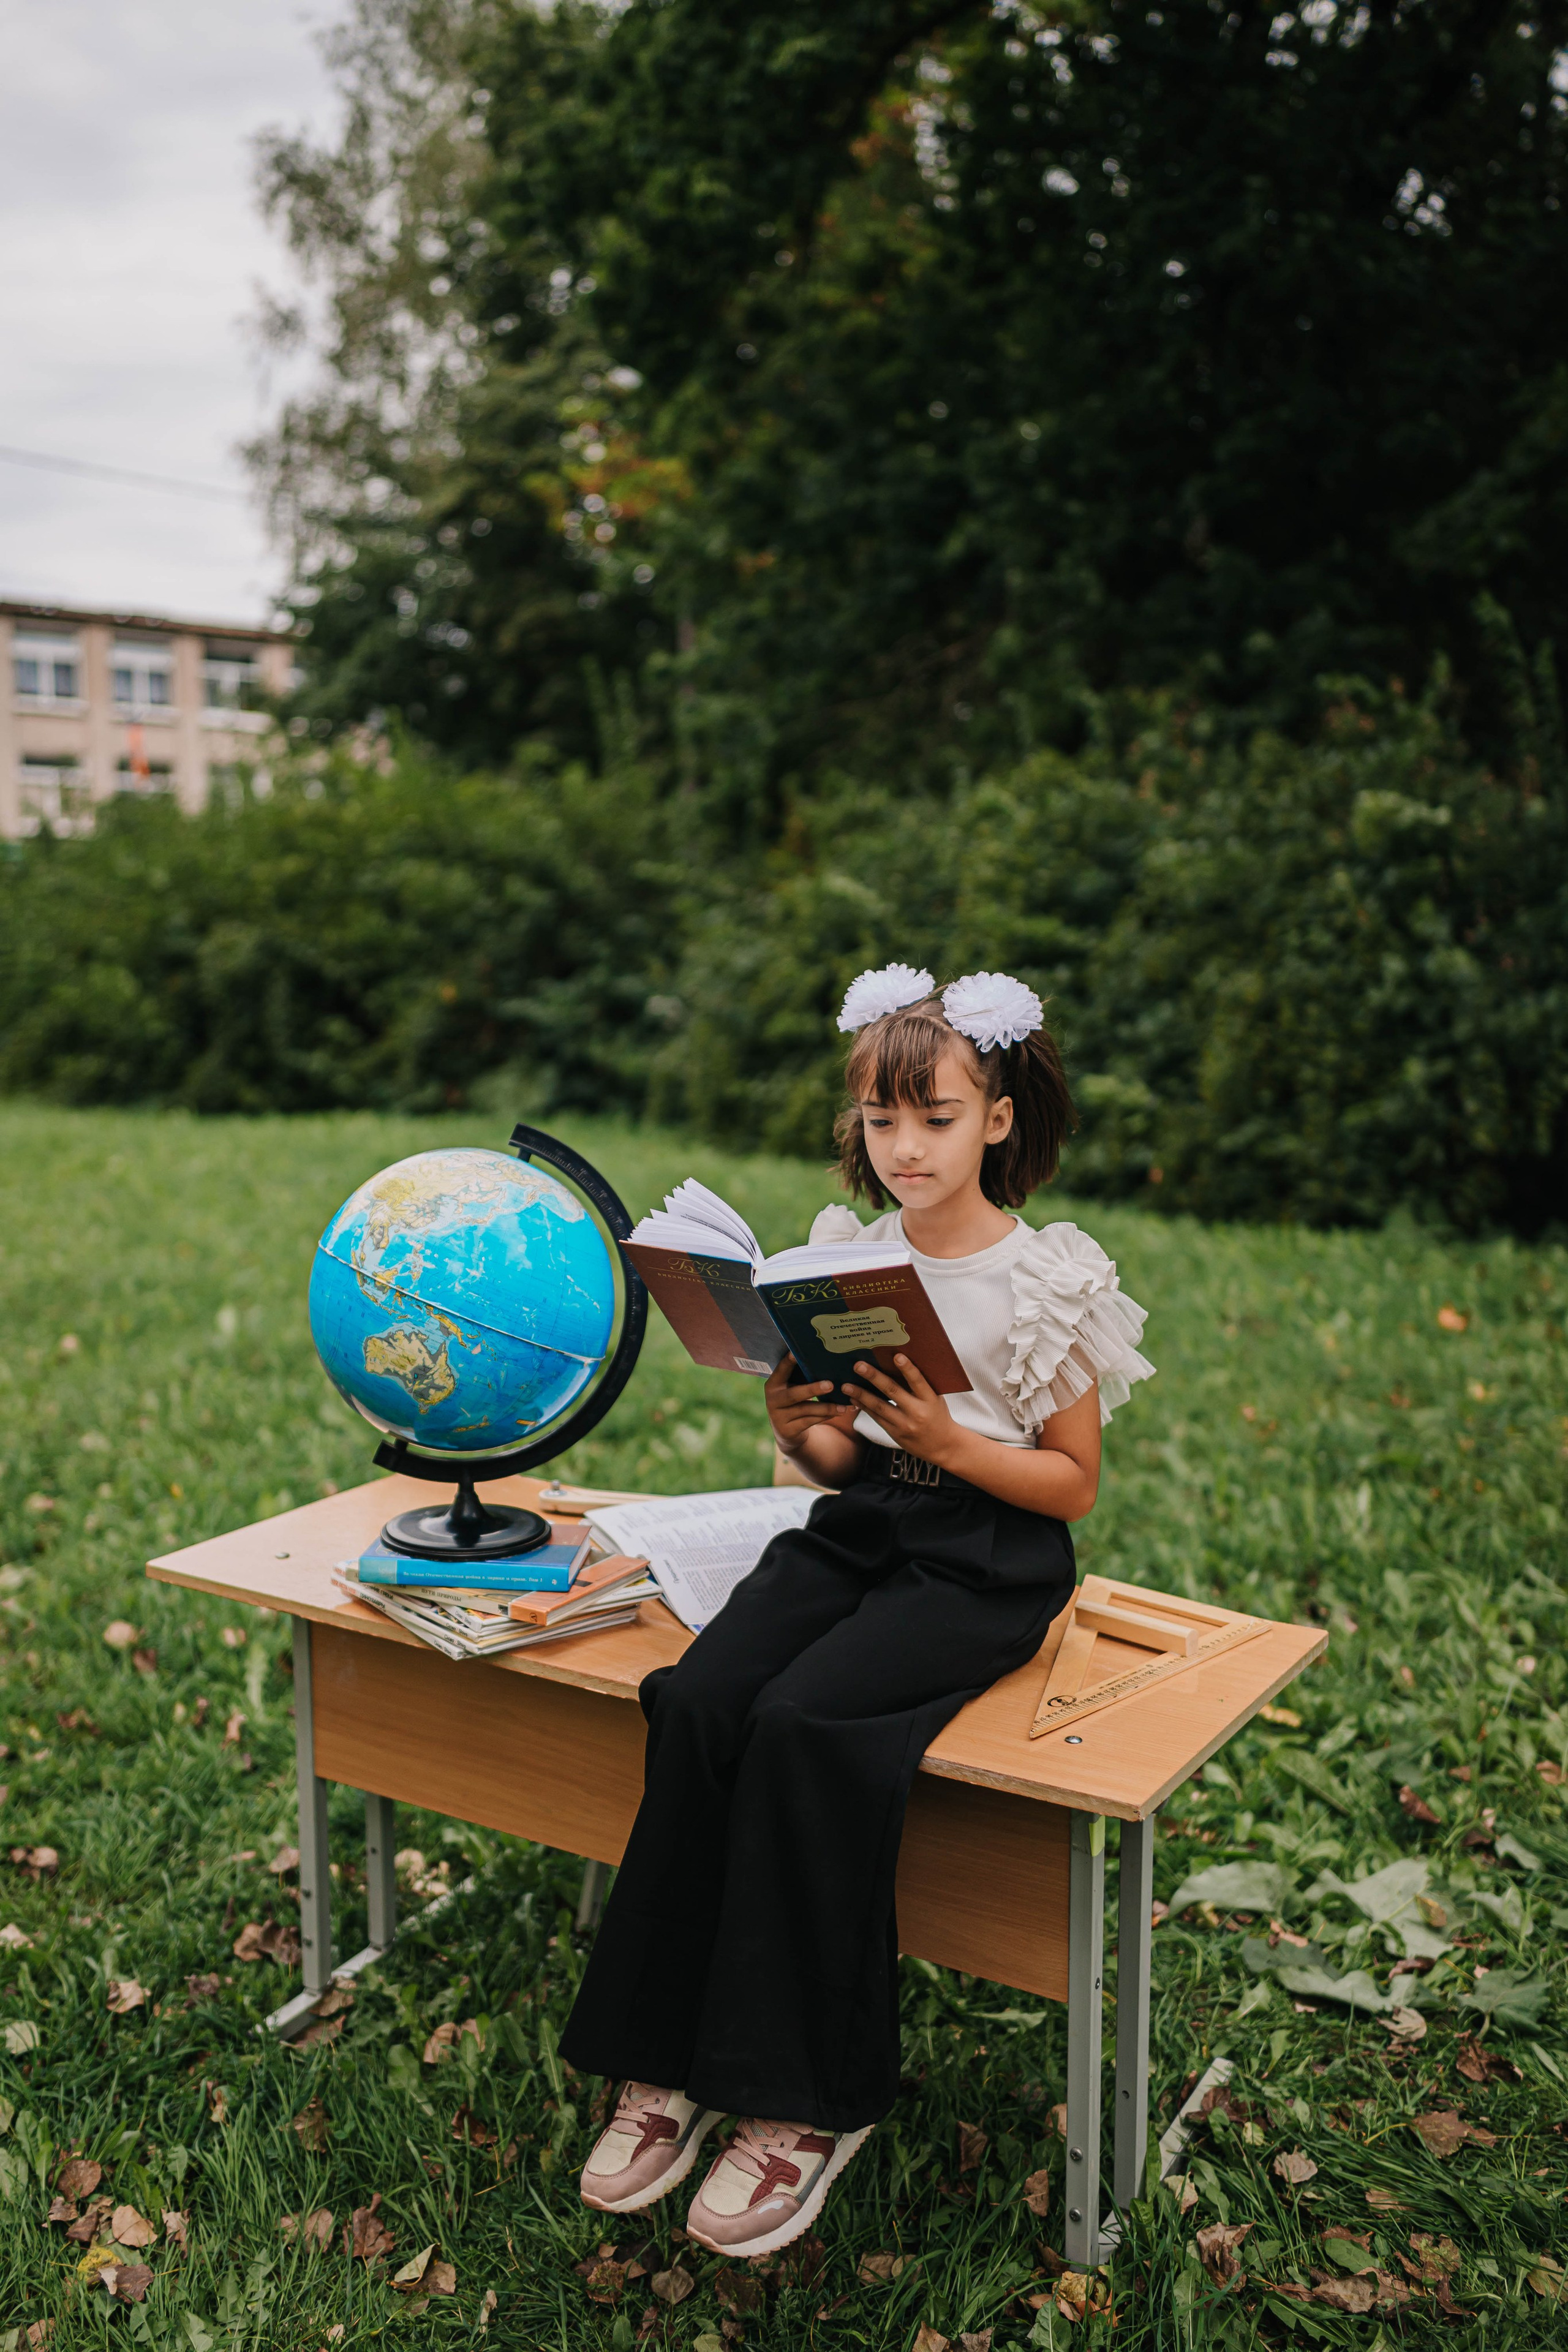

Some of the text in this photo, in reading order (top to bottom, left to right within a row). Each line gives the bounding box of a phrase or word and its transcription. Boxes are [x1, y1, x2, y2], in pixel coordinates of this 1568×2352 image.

[657, 1273, 751, 1291] БИБЛИОТЕКА КЛАССИКИ
[843, 1278, 906, 1291] БИБЛИОТЕКА
[846, 1286, 897, 1296] КЛАССИКИ
[830, 1319, 885, 1330] Отечественная
[437, 1592, 462, 1602] ПРИРОДЫ
